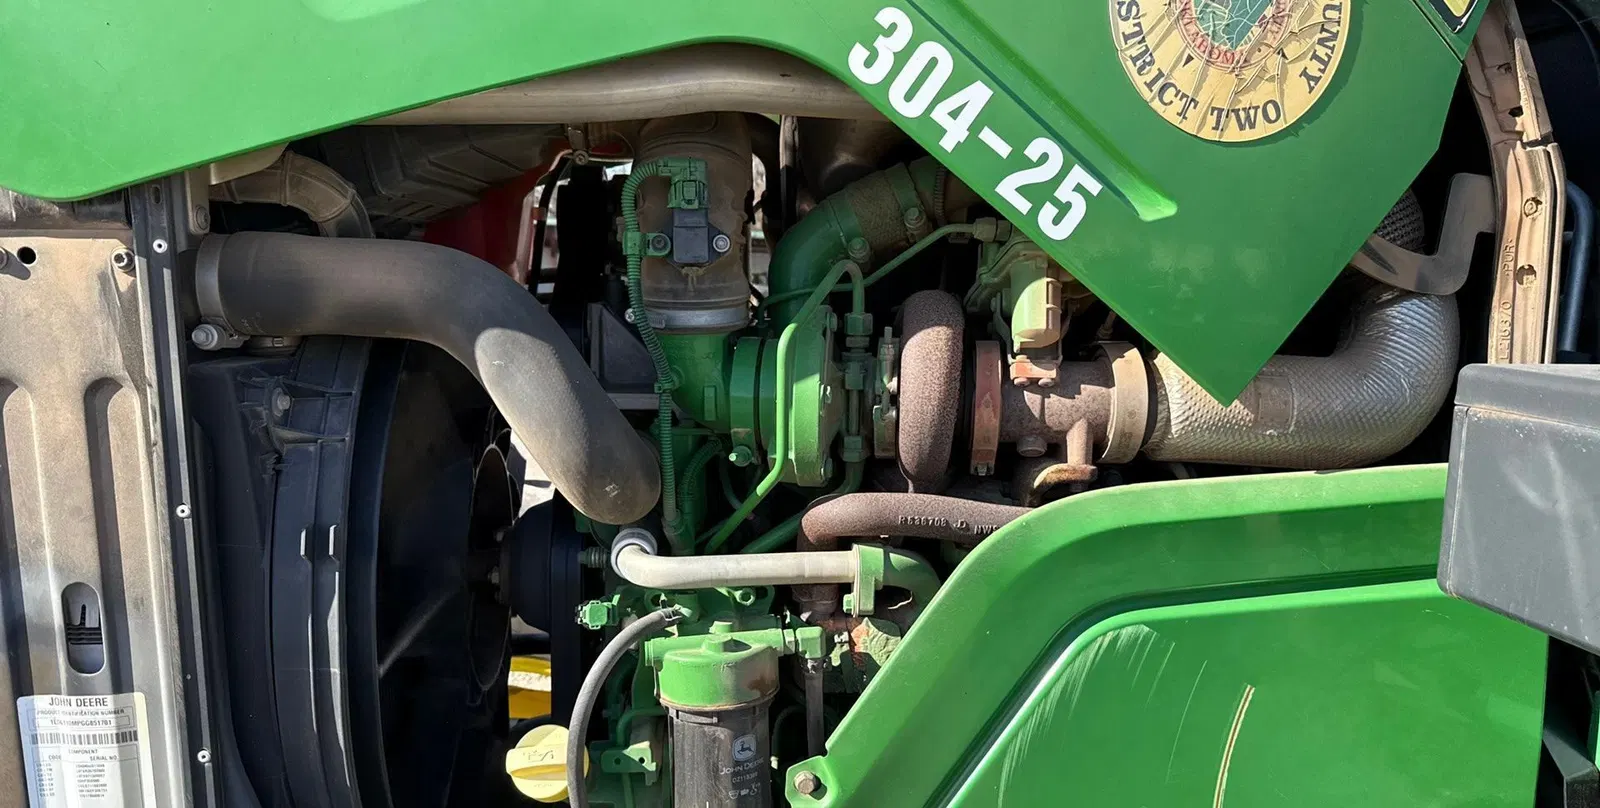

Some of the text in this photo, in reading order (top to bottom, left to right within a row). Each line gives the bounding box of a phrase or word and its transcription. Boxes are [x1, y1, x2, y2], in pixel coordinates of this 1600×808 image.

[848, 6, 1104, 241] 304-25
[1210, 99, 1282, 132] TWO
[49, 697, 109, 707] JOHN DEERE
[100, 708, 125, 717] NUMBER
[720, 757, 764, 775] JOHN DEERE
